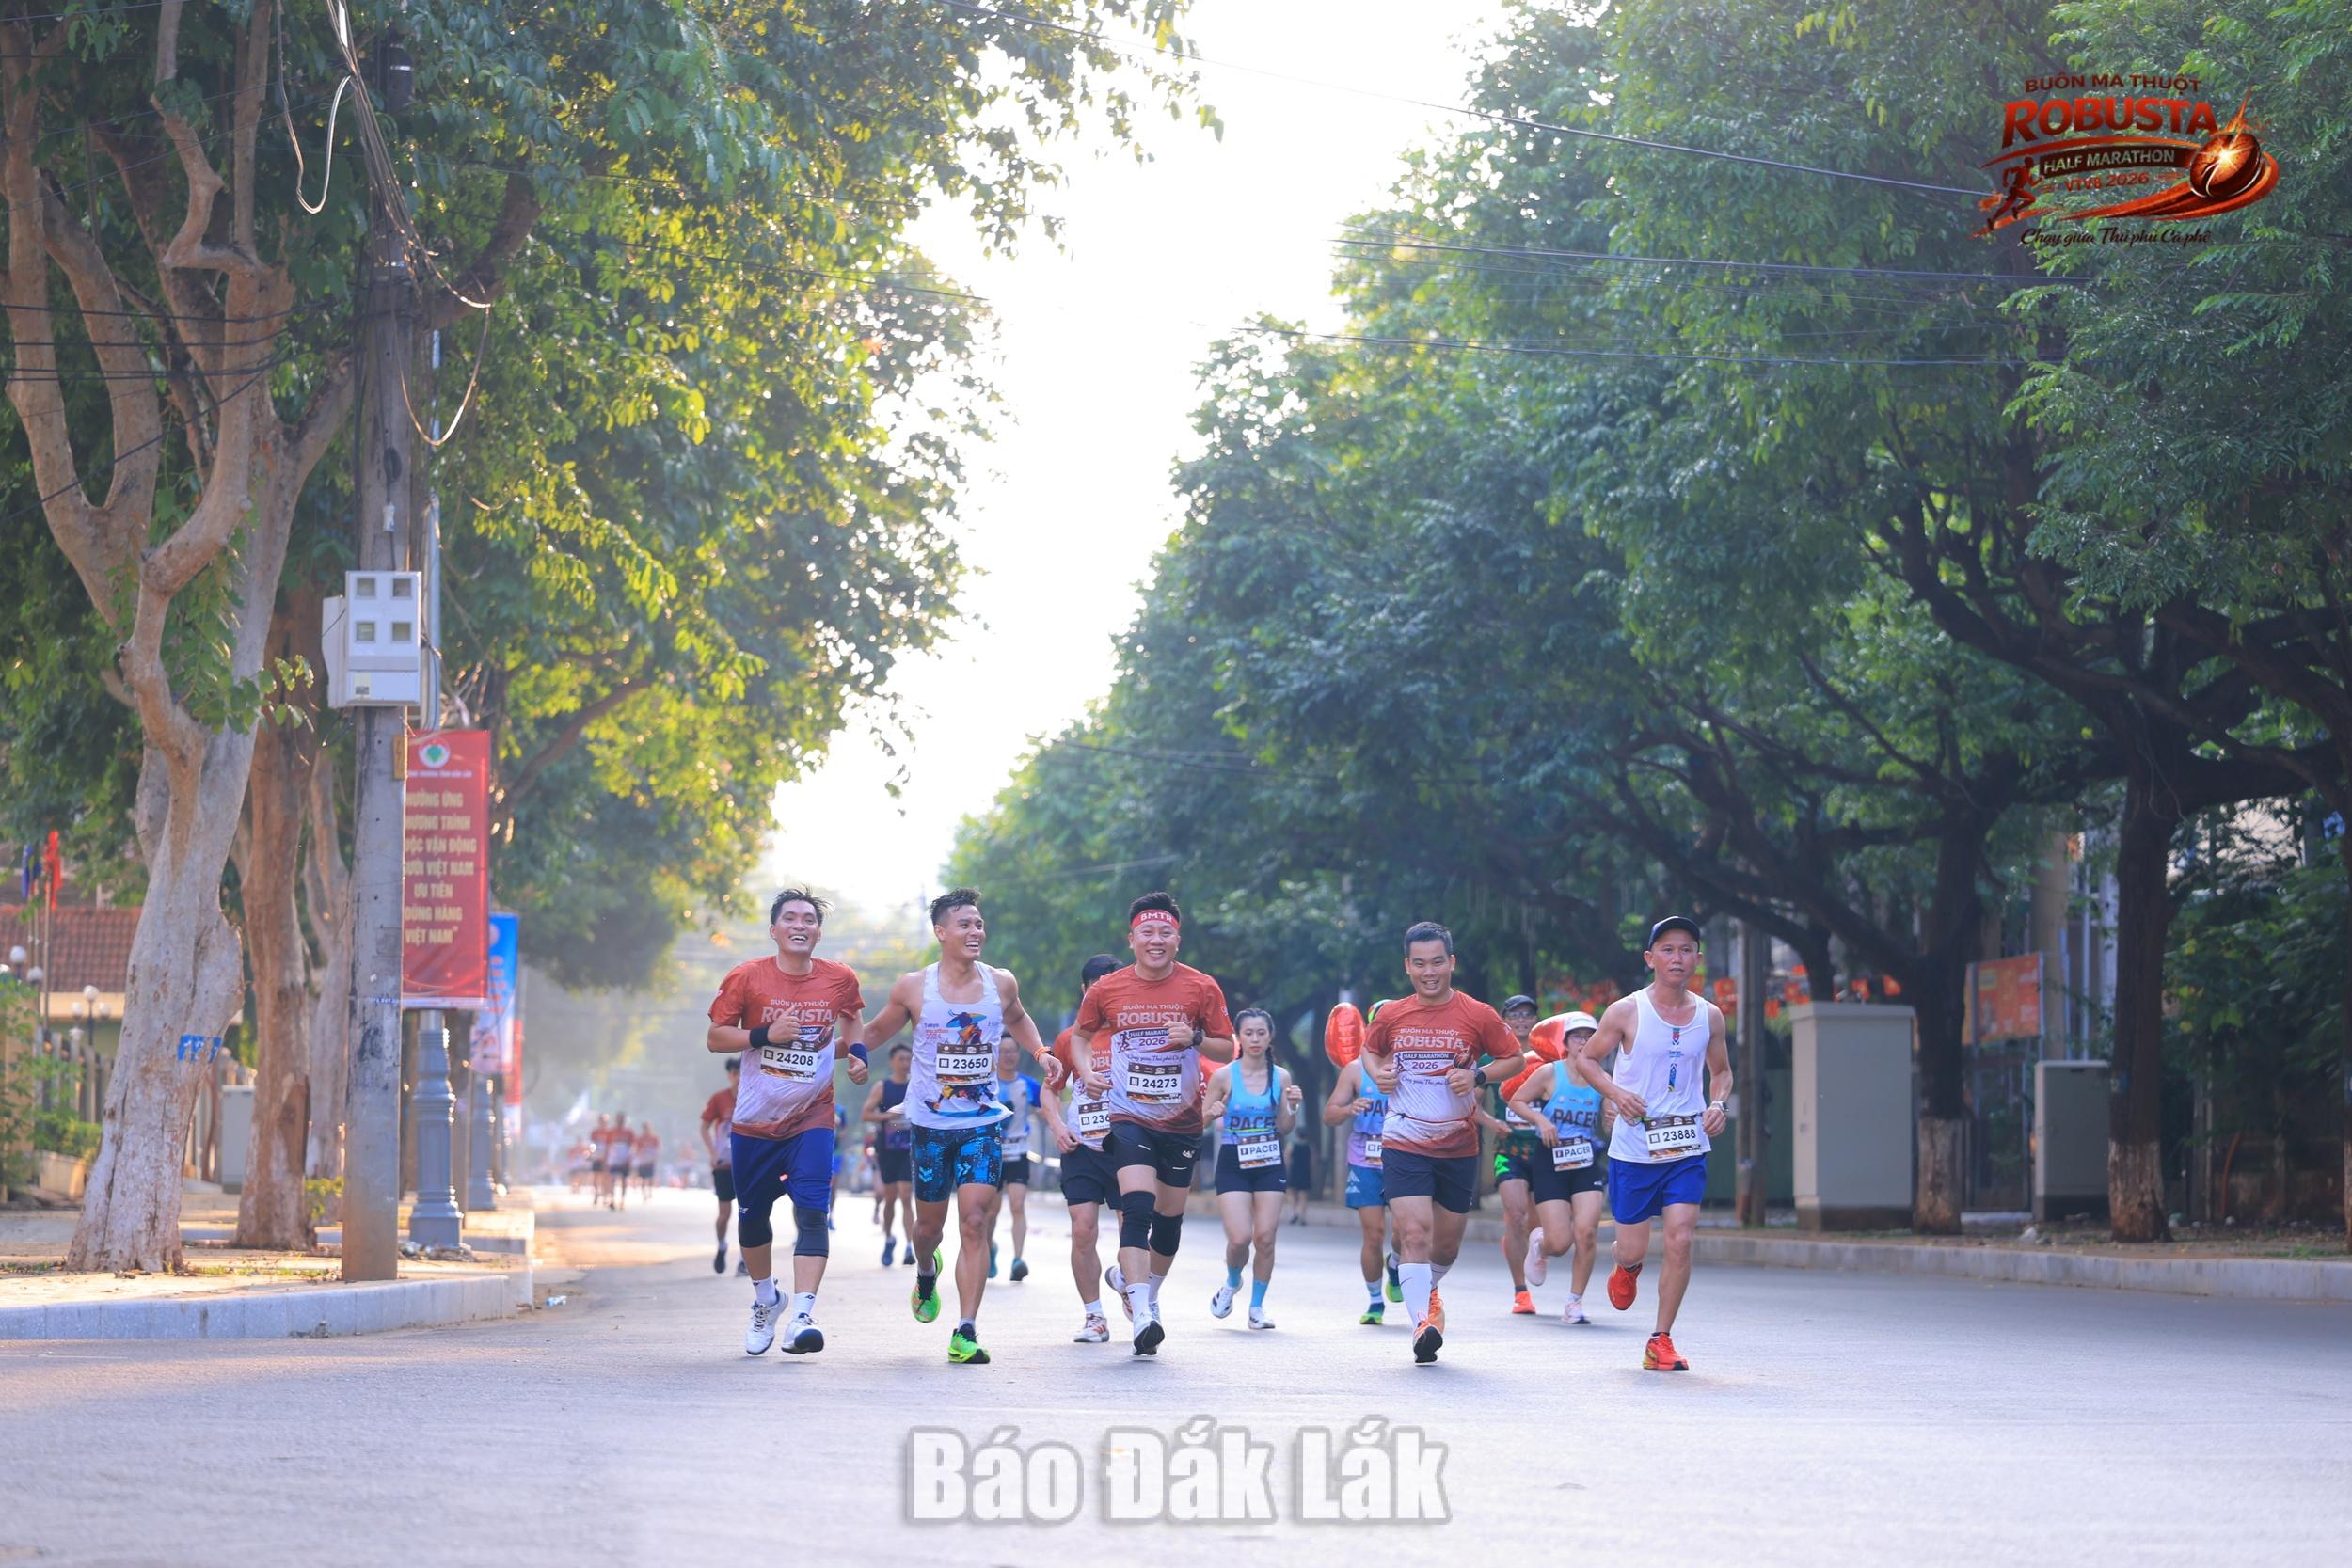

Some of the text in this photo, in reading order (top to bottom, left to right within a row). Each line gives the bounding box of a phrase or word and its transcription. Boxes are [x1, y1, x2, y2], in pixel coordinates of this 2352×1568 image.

[451, 861, 474, 876] NAM
[1140, 912, 1172, 922] BMTR
[760, 1006, 834, 1023] ROUSTA
[1117, 1012, 1189, 1028] ROBUSTA
[1138, 1037, 1166, 1046] 2026
[1393, 1035, 1464, 1050] ROBUSTA
[776, 1053, 814, 1066] 24208
[952, 1057, 989, 1069] 23650
[1411, 1061, 1438, 1069] 2026
[1142, 1078, 1178, 1088] 24273
[1091, 1114, 1110, 1124] 236
[1662, 1129, 1696, 1142] 23888
[1249, 1143, 1279, 1155] PACER
[1565, 1146, 1591, 1157] PACER
